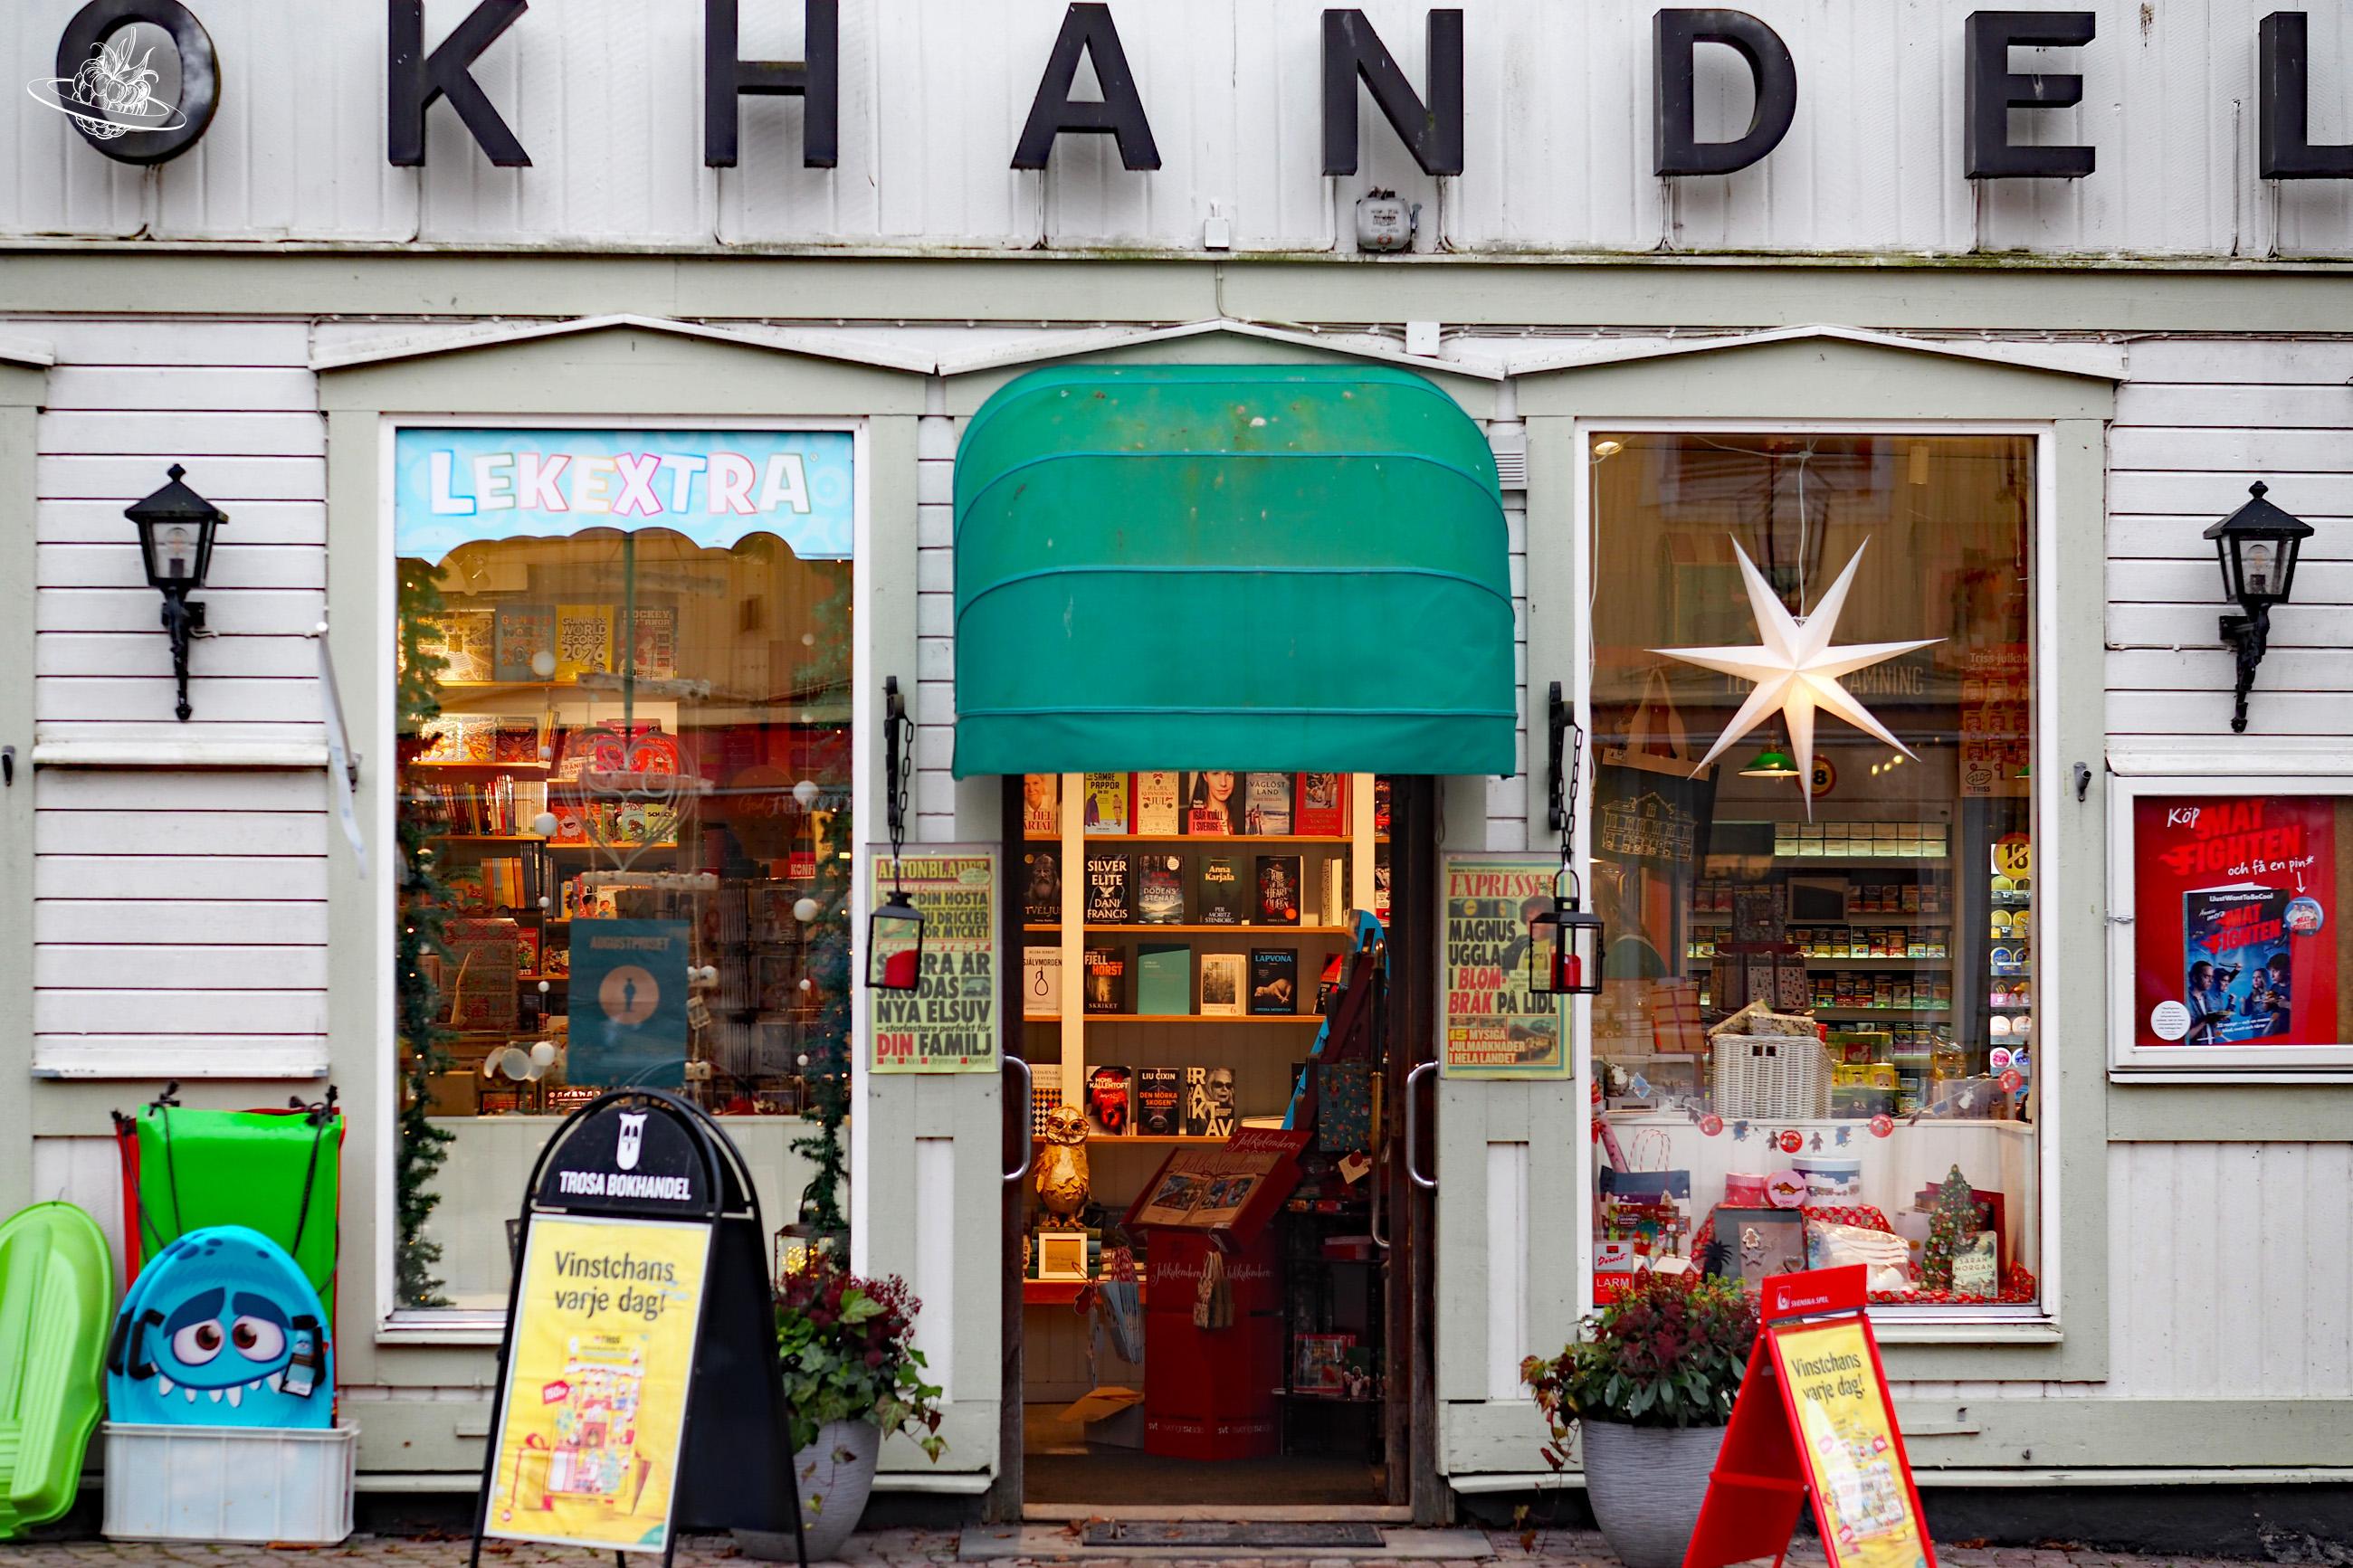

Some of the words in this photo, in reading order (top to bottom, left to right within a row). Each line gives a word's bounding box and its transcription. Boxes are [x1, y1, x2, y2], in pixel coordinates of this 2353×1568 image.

[430, 450, 811, 517] LEKEXTRA
[562, 616, 606, 624] GUINNESS
[562, 625, 607, 634] WORLD
[561, 635, 606, 643] RECORDS
[561, 644, 606, 666] 2026
[1091, 781, 1119, 789] PAPPOR
[2167, 806, 2200, 829] Köp
[1196, 822, 1218, 831] SVERIGE
[2005, 843, 2028, 869] 18
[1087, 860, 1127, 872] SILVER
[1209, 865, 1231, 873] Anna
[2227, 861, 2249, 876] och
[2252, 859, 2265, 874] få
[2270, 861, 2286, 871] en
[1091, 874, 1123, 886] ELITE
[1205, 873, 1235, 882] Karjala
[1449, 874, 1555, 897] EXPRESSE
[919, 892, 940, 904] DIN
[945, 892, 987, 904] HOSTA
[1094, 898, 1119, 908] DANI
[937, 912, 987, 924] DRICKER
[1087, 909, 1128, 918] FRANCIS
[943, 926, 988, 937] MYCKET
[1449, 920, 1516, 942] MAGNUS
[1085, 955, 1108, 965] FJELL
[1448, 944, 1501, 966] UGGLA
[960, 952, 990, 975] ÄR
[1092, 965, 1122, 976] HORST
[1448, 968, 1453, 990] I
[1458, 967, 1507, 990] BLOM-
[1448, 991, 1492, 1013] BRÅK
[1497, 991, 1518, 1013] PÅ
[1523, 993, 1556, 1013] LIDL
[877, 1001, 921, 1022] NYA
[927, 1001, 991, 1022] ELSUV
[1449, 1028, 1467, 1041] 15
[1469, 1028, 1506, 1041] MYSIGA
[877, 1033, 913, 1056] DIN
[919, 1033, 991, 1056] FAMILJ
[1449, 1041, 1525, 1052] JULMARKNADER
[1454, 1052, 1479, 1064] HELA
[1480, 1052, 1517, 1064] LANDET
[1227, 1132, 1301, 1152] Julkalendern
[559, 1171, 605, 1195] TROSA
[606, 1174, 691, 1201] BOKHANDEL
[554, 1250, 675, 1282] Vinstchans
[1954, 1263, 1993, 1271] MORGAN
[1149, 1261, 1203, 1288] Julkalendern
[1596, 1278, 1629, 1288] LARM
[554, 1286, 610, 1319] varje
[618, 1289, 667, 1322] dag!
[1791, 1352, 1862, 1378] Vinstchans
[1802, 1382, 1834, 1404] varje
[1837, 1373, 1866, 1400] dag!
[1148, 1422, 1158, 1430] svt
[1218, 1425, 1229, 1434] svt
